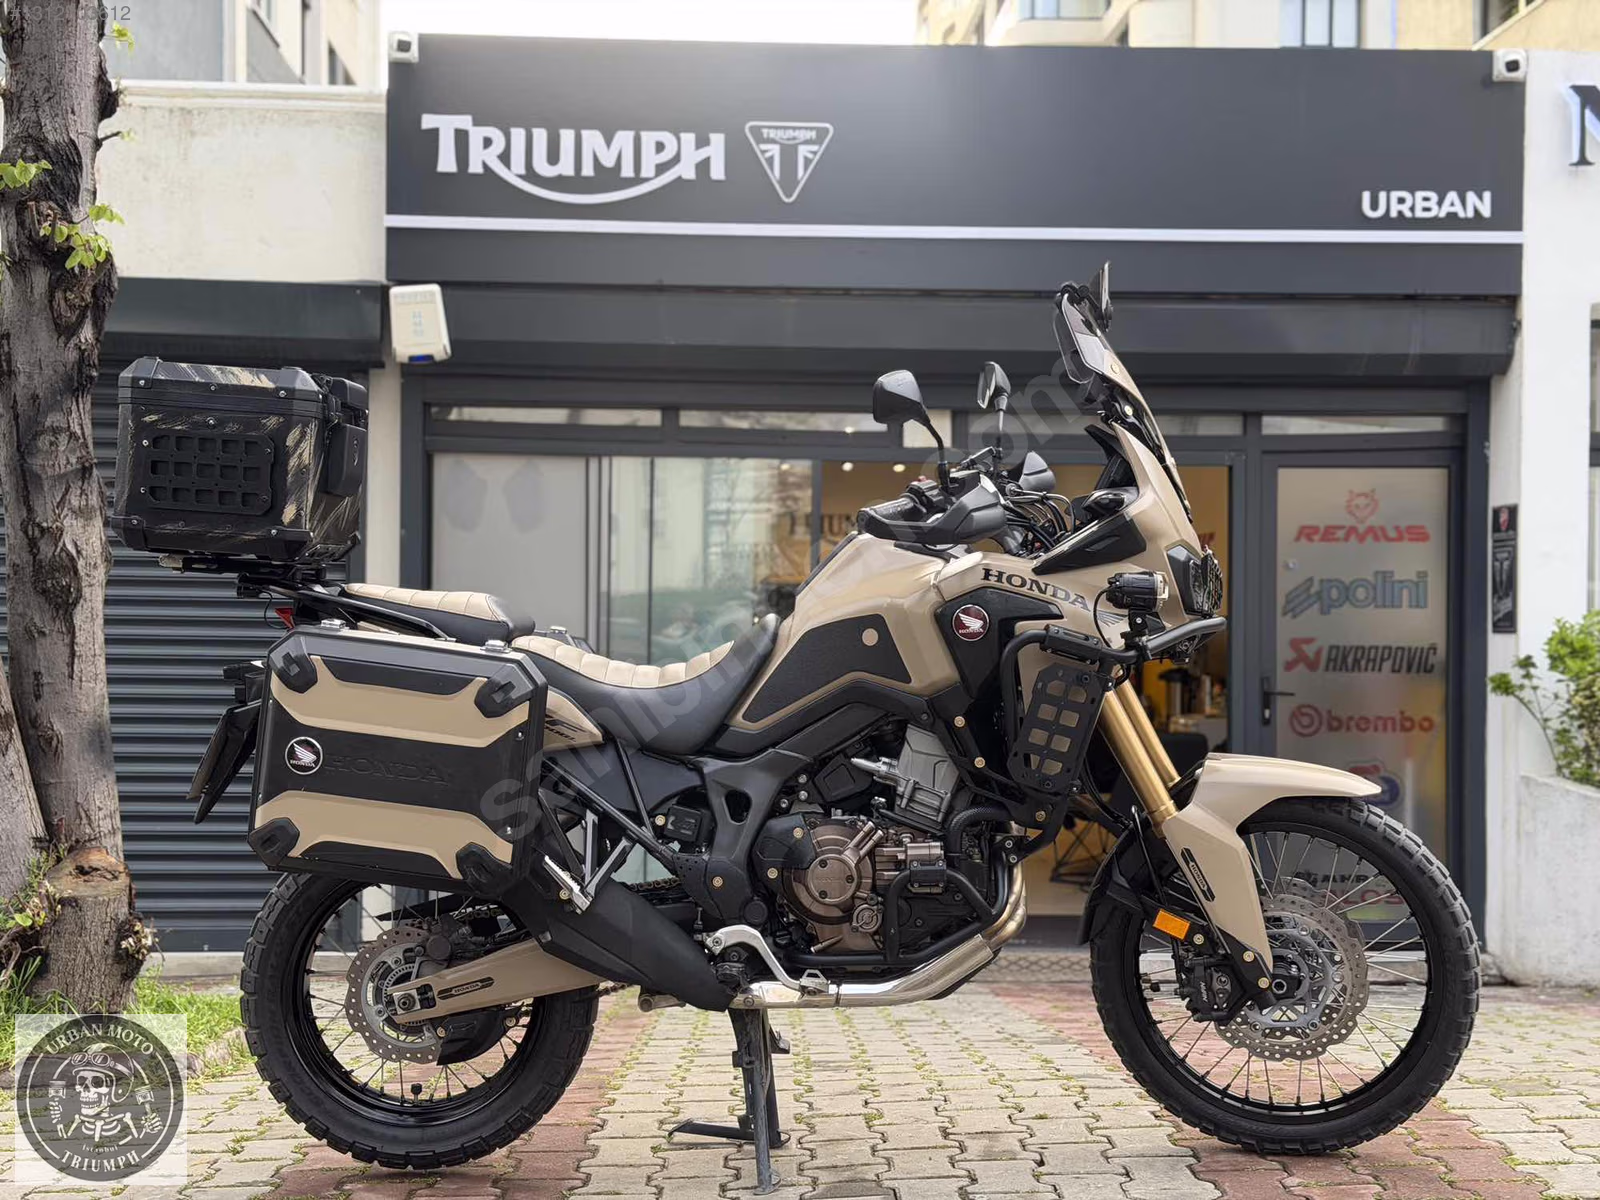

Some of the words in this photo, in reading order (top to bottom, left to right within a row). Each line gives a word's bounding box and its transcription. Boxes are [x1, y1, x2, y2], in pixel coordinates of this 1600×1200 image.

[761, 127, 817, 144] TRIUMPH
[421, 113, 726, 204] TRIUMPH
[1361, 190, 1492, 218] URBAN
[1294, 525, 1431, 544] REMUS
[981, 567, 1091, 612] HONDA
[1319, 570, 1429, 616] polini
[1327, 710, 1435, 734] brembo
